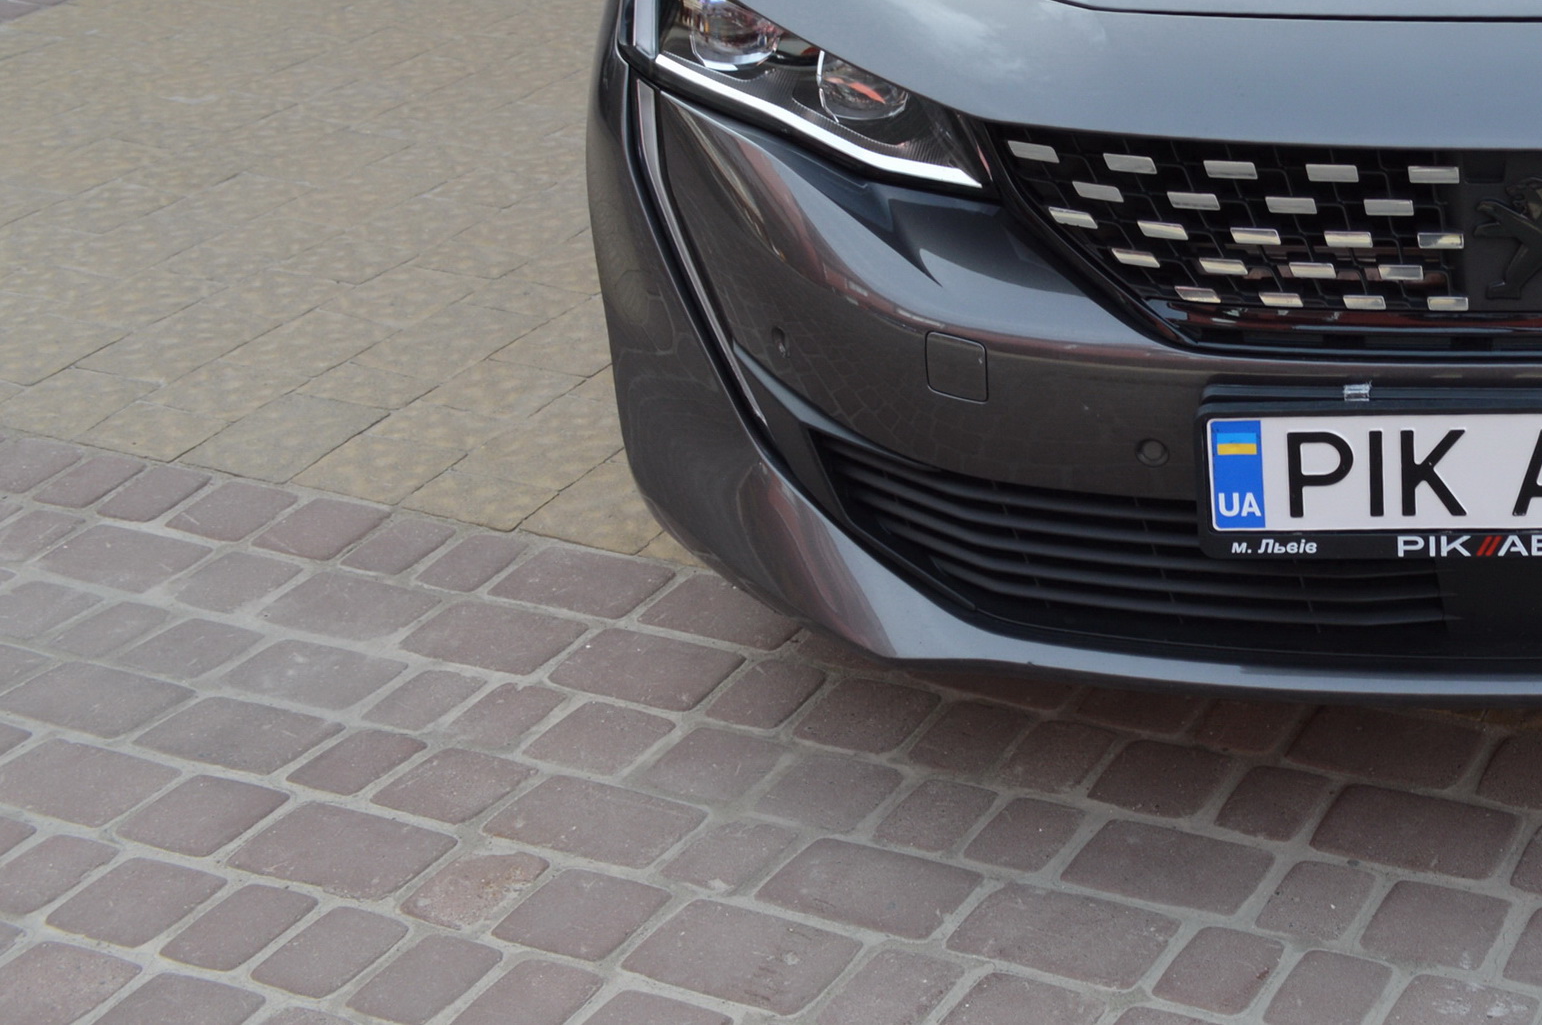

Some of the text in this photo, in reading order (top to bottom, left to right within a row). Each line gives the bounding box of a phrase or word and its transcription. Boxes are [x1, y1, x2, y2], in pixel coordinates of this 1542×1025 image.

[1286, 427, 1468, 518] РІК
[1217, 491, 1262, 518] UA
[1231, 538, 1318, 554] м. Львів
